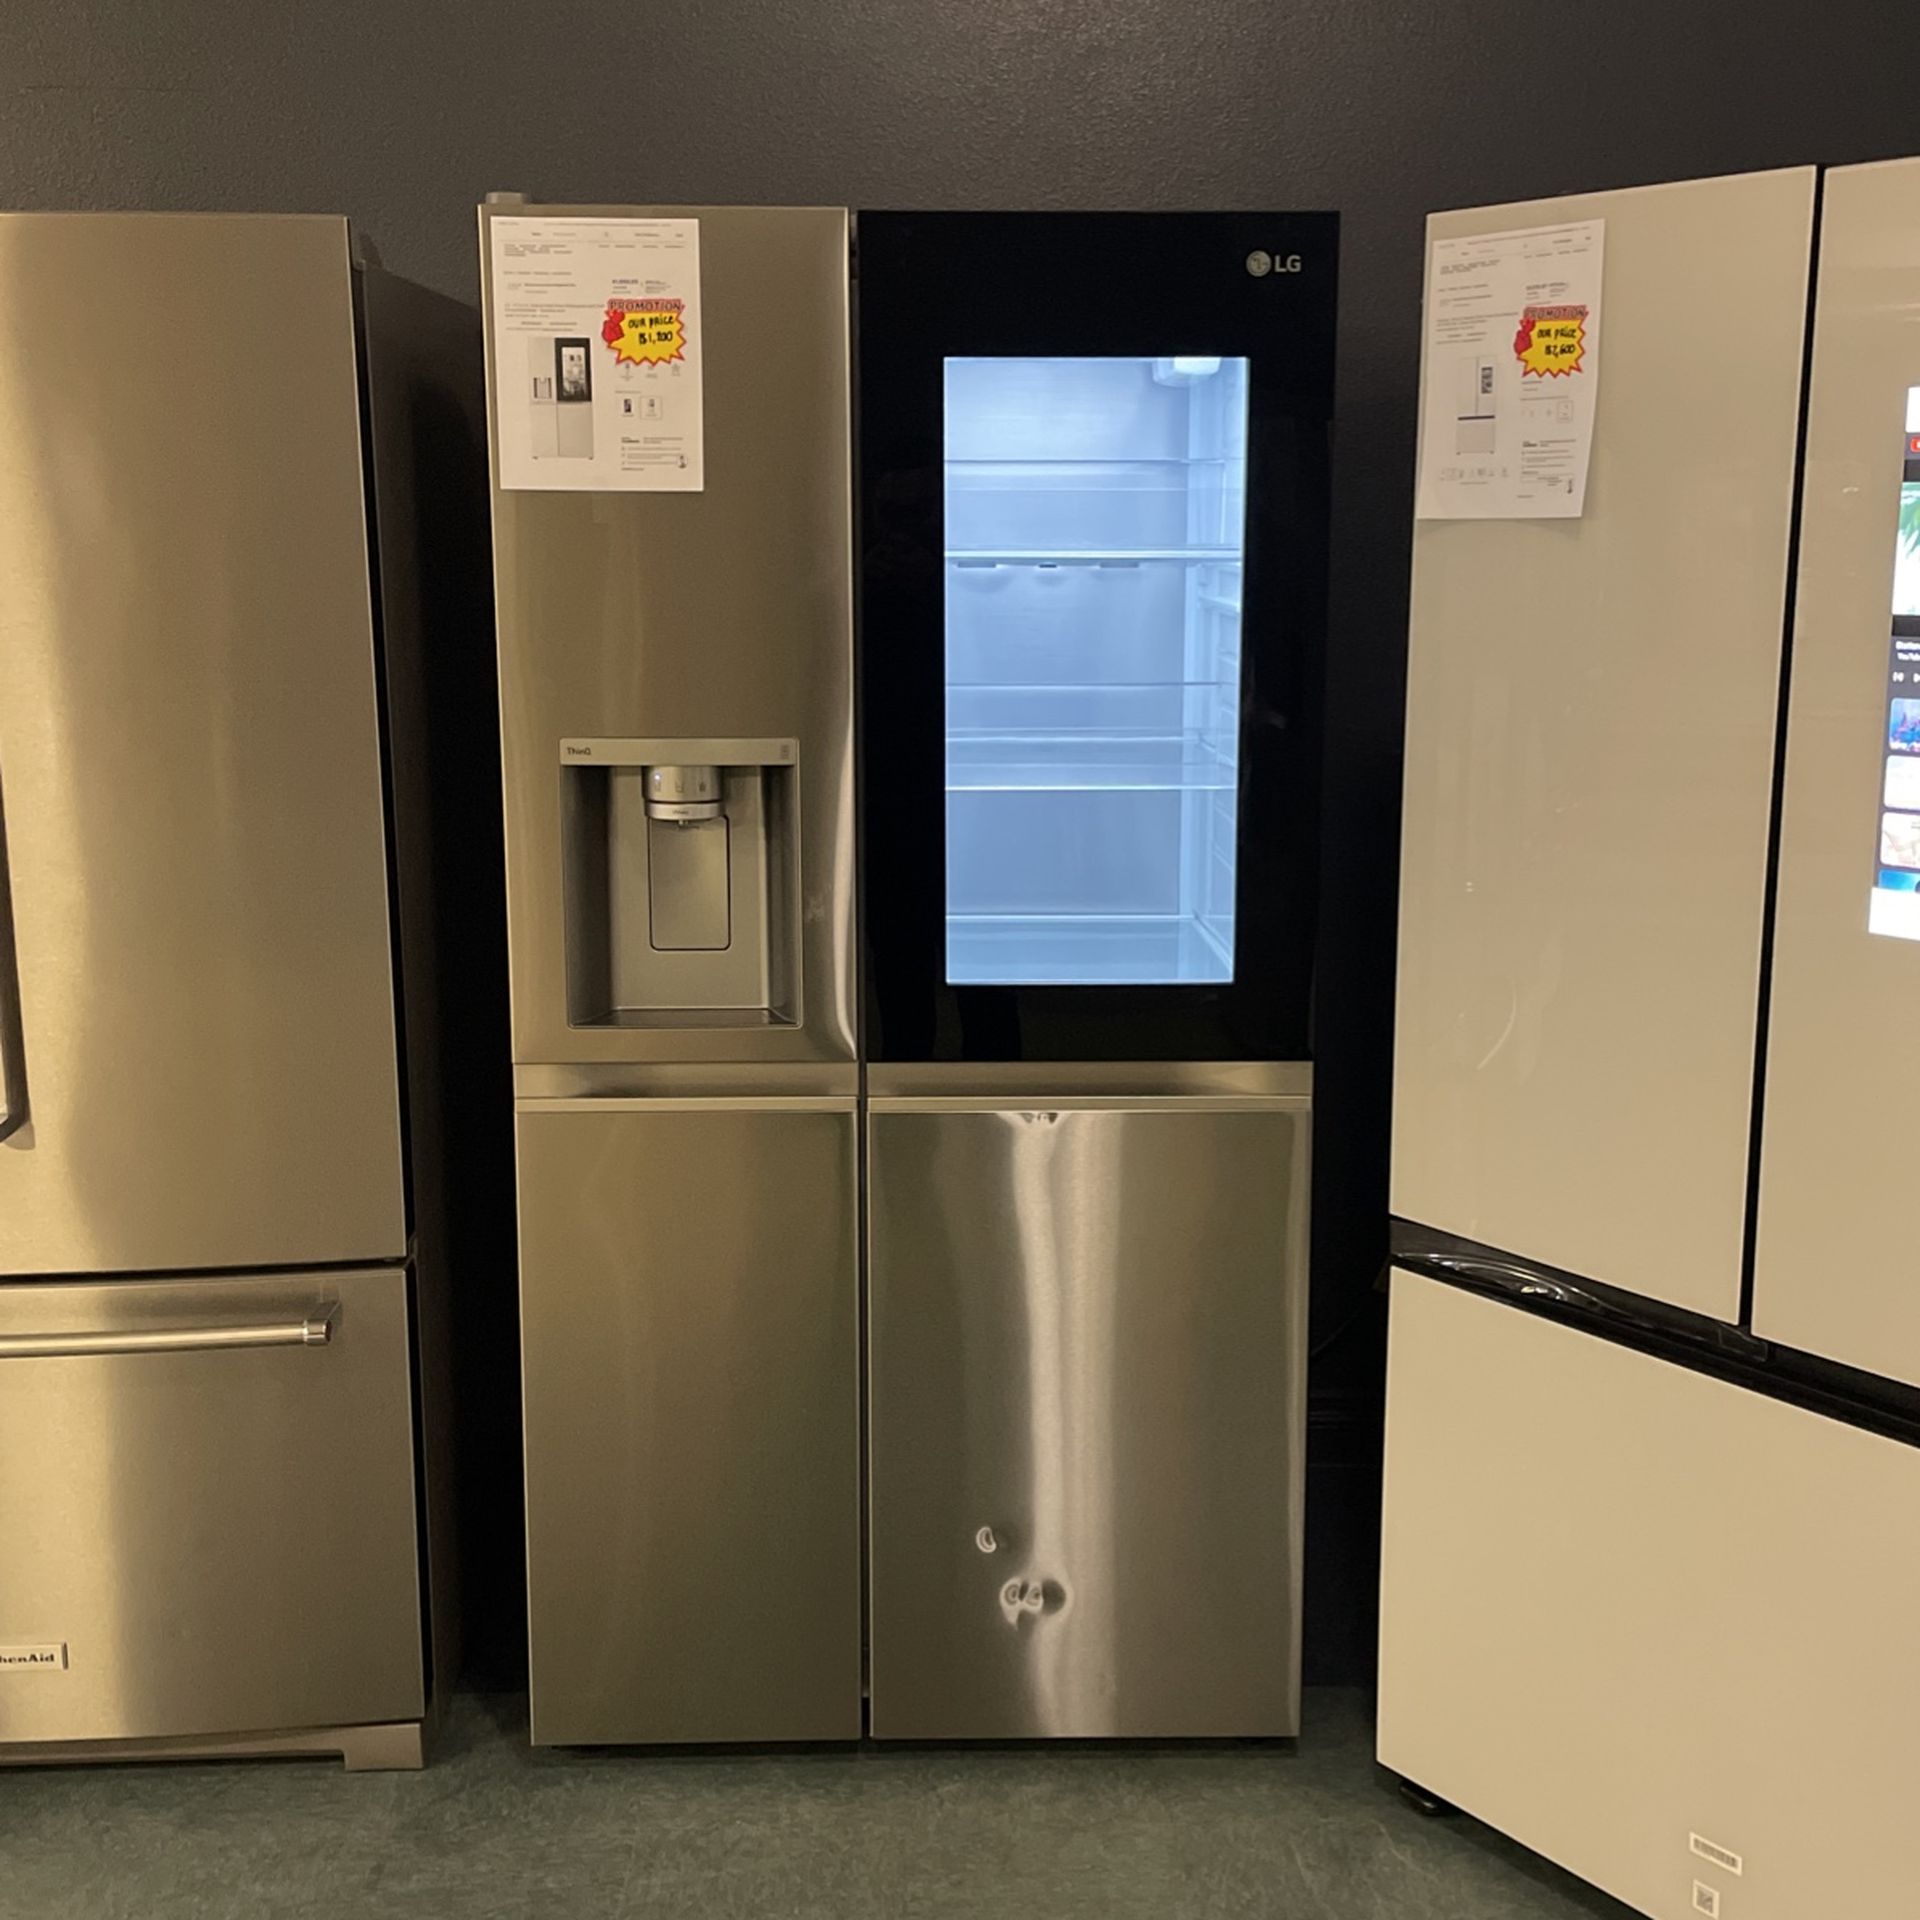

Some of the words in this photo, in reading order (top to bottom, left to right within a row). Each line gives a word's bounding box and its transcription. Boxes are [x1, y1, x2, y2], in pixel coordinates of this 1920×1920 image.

[1274, 255, 1301, 272] LG
[610, 301, 681, 311] PROMOTION
[1523, 306, 1585, 319] PROMOTION
[567, 746, 592, 756] ThinQ
